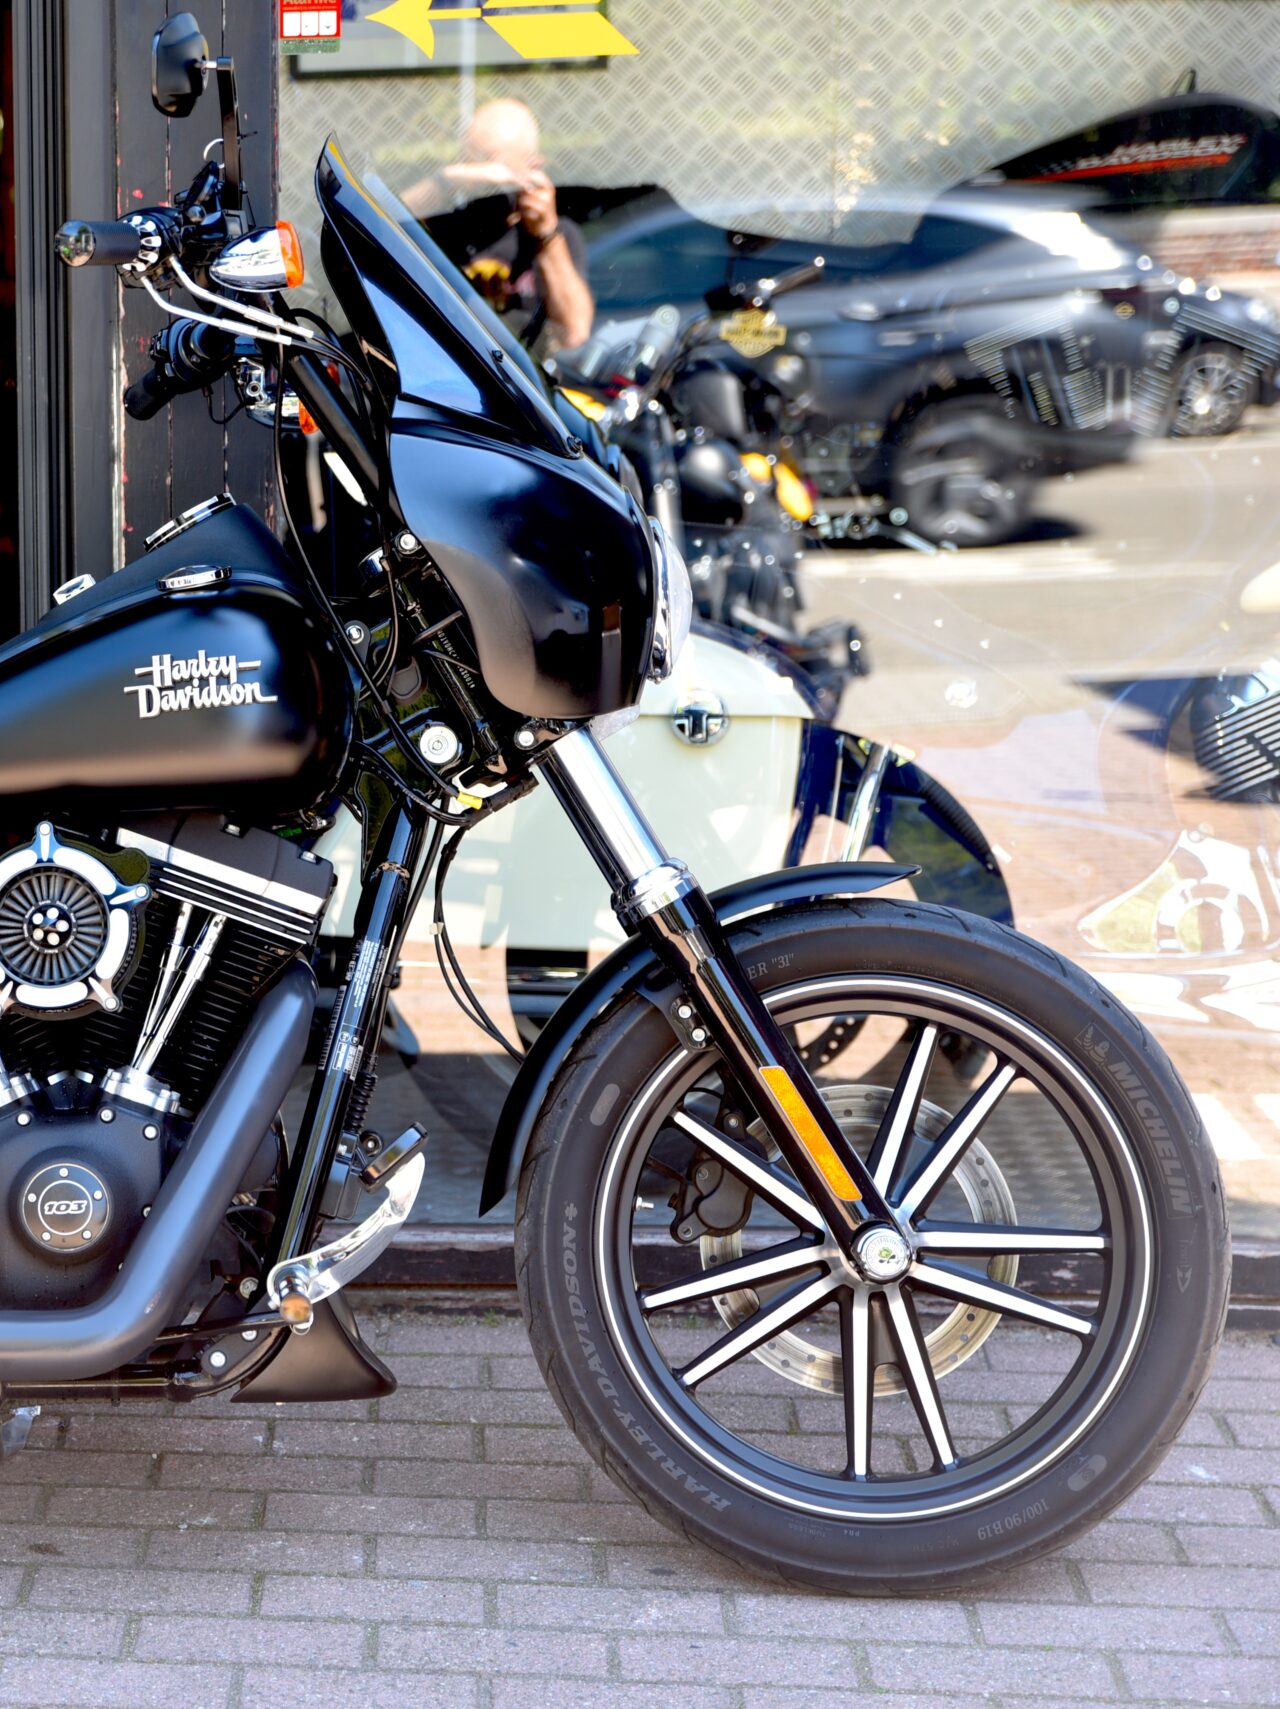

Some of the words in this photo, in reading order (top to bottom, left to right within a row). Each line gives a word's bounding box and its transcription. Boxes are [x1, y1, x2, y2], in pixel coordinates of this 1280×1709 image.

[124, 650, 261, 687] Harley
[113, 674, 278, 718] Davidson
[1108, 1060, 1193, 1215] MICHELIN
[44, 1200, 88, 1215] 103
[562, 1223, 733, 1513] HARLEY-DAVIDSON
[977, 1521, 1003, 1541] B19
[1004, 1498, 1050, 1536] 100/90
